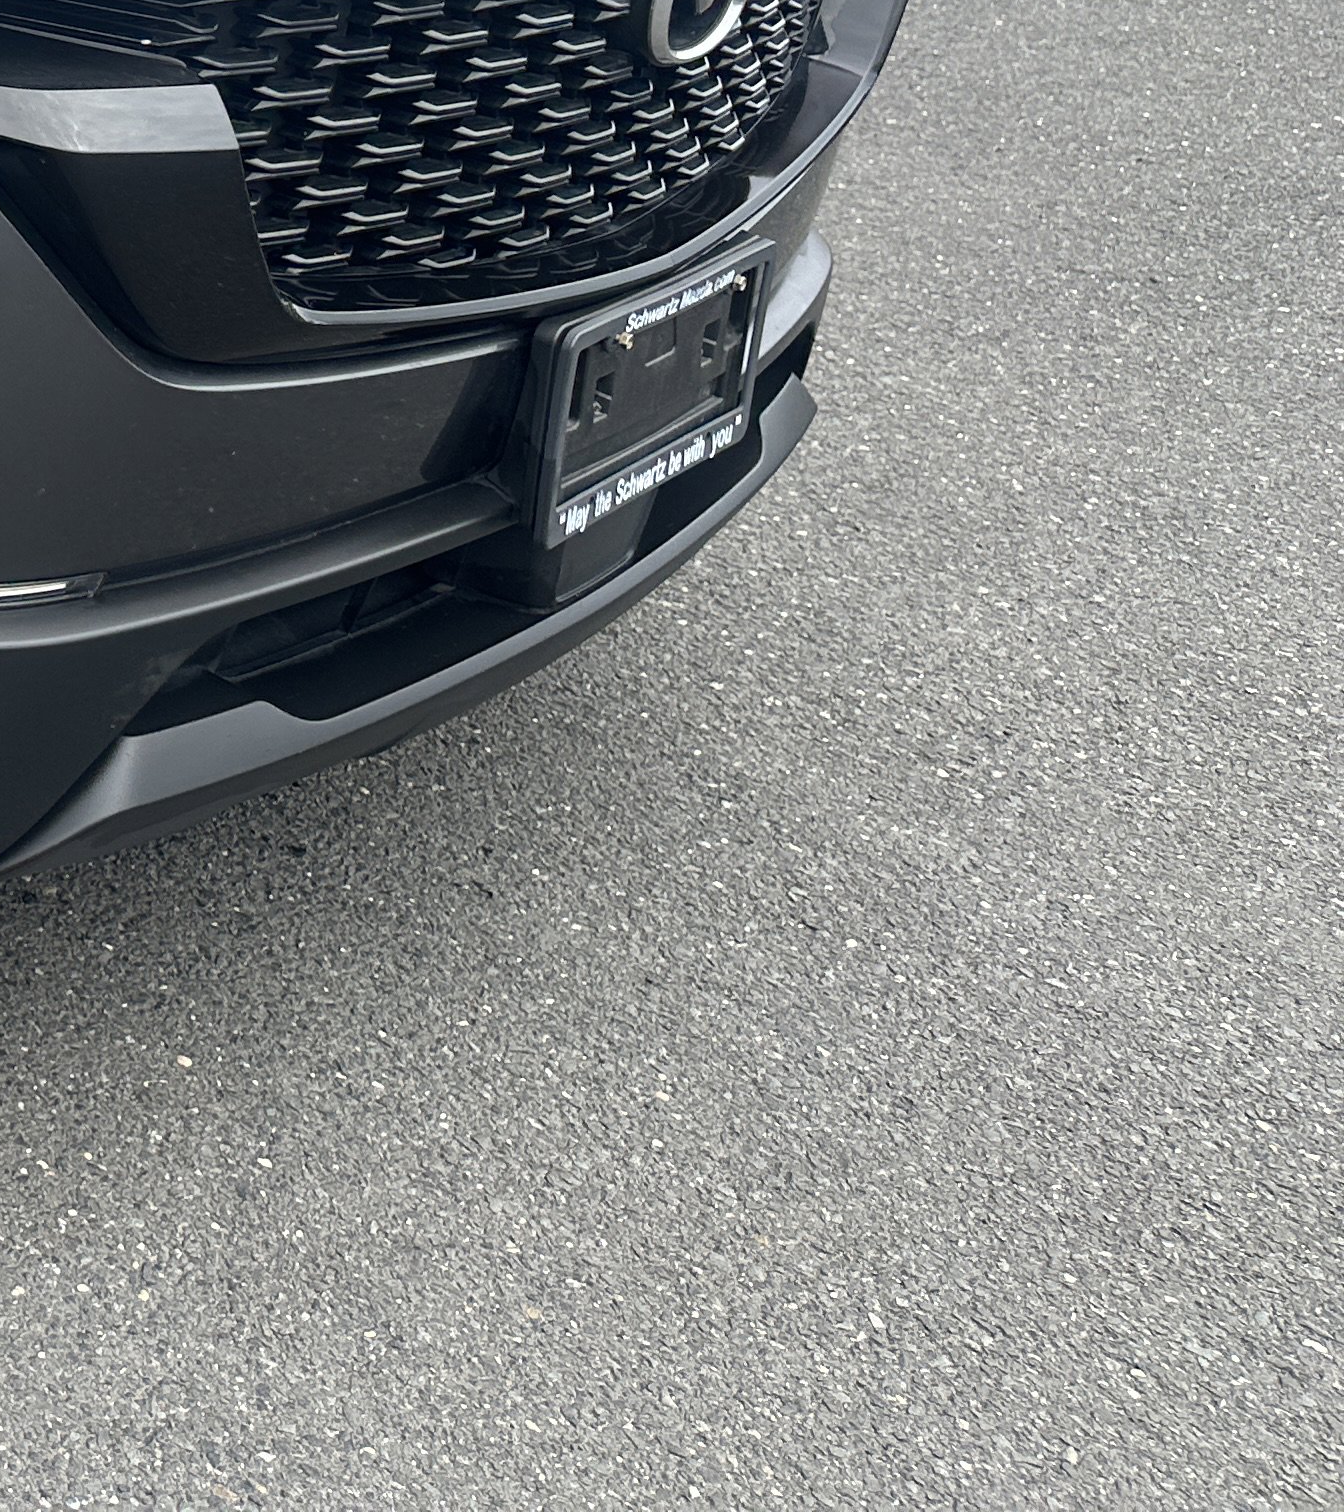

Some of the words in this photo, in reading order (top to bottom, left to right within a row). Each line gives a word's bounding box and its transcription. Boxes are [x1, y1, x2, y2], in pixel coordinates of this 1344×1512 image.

[625, 296, 681, 333] Schwartz
[594, 488, 613, 518] the
[615, 458, 667, 505] Schwartz
[667, 449, 682, 476] be
[683, 436, 706, 467] with
